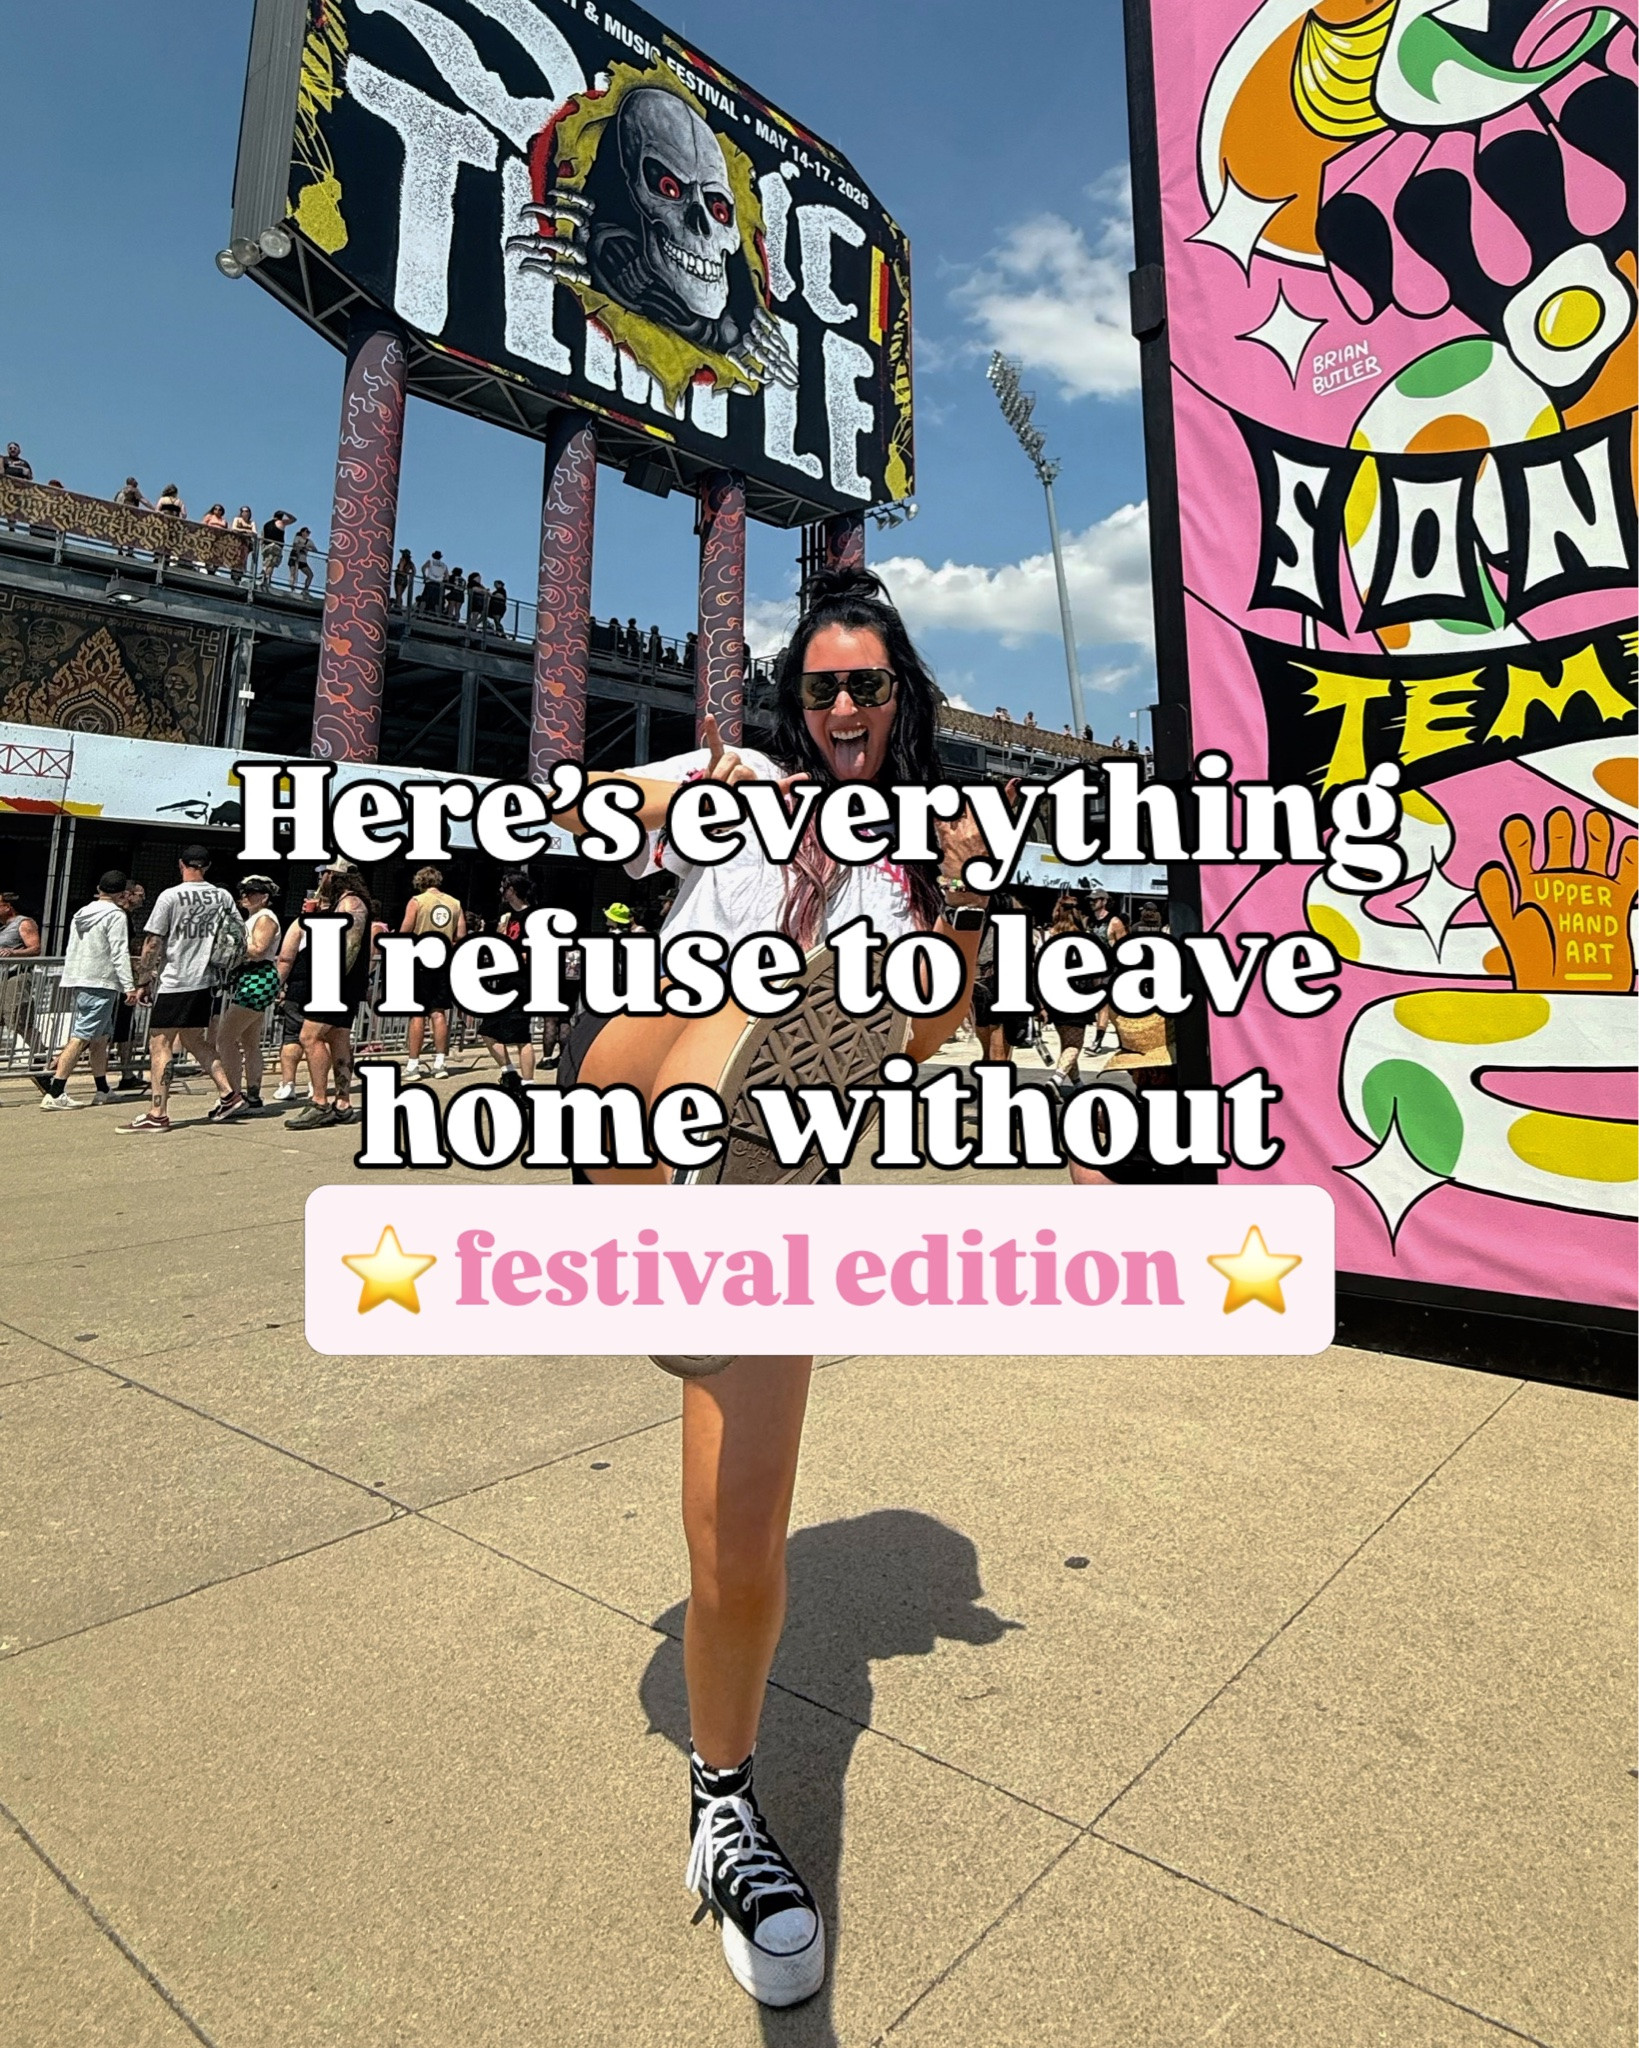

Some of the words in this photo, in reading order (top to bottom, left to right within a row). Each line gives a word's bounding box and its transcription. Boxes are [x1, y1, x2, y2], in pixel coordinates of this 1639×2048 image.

[583, 0, 600, 26] &
[604, 12, 662, 65] MUSIC
[666, 55, 740, 122] FESTIVAL
[755, 117, 789, 154] MAY
[837, 176, 870, 211] 2026
[1312, 339, 1369, 374] BRIAN
[1312, 355, 1382, 397] BUTLER
[1534, 878, 1613, 908] UPPER
[175, 922, 216, 940] MUER
[1558, 912, 1619, 937] HAND
[1565, 939, 1615, 965] ART
